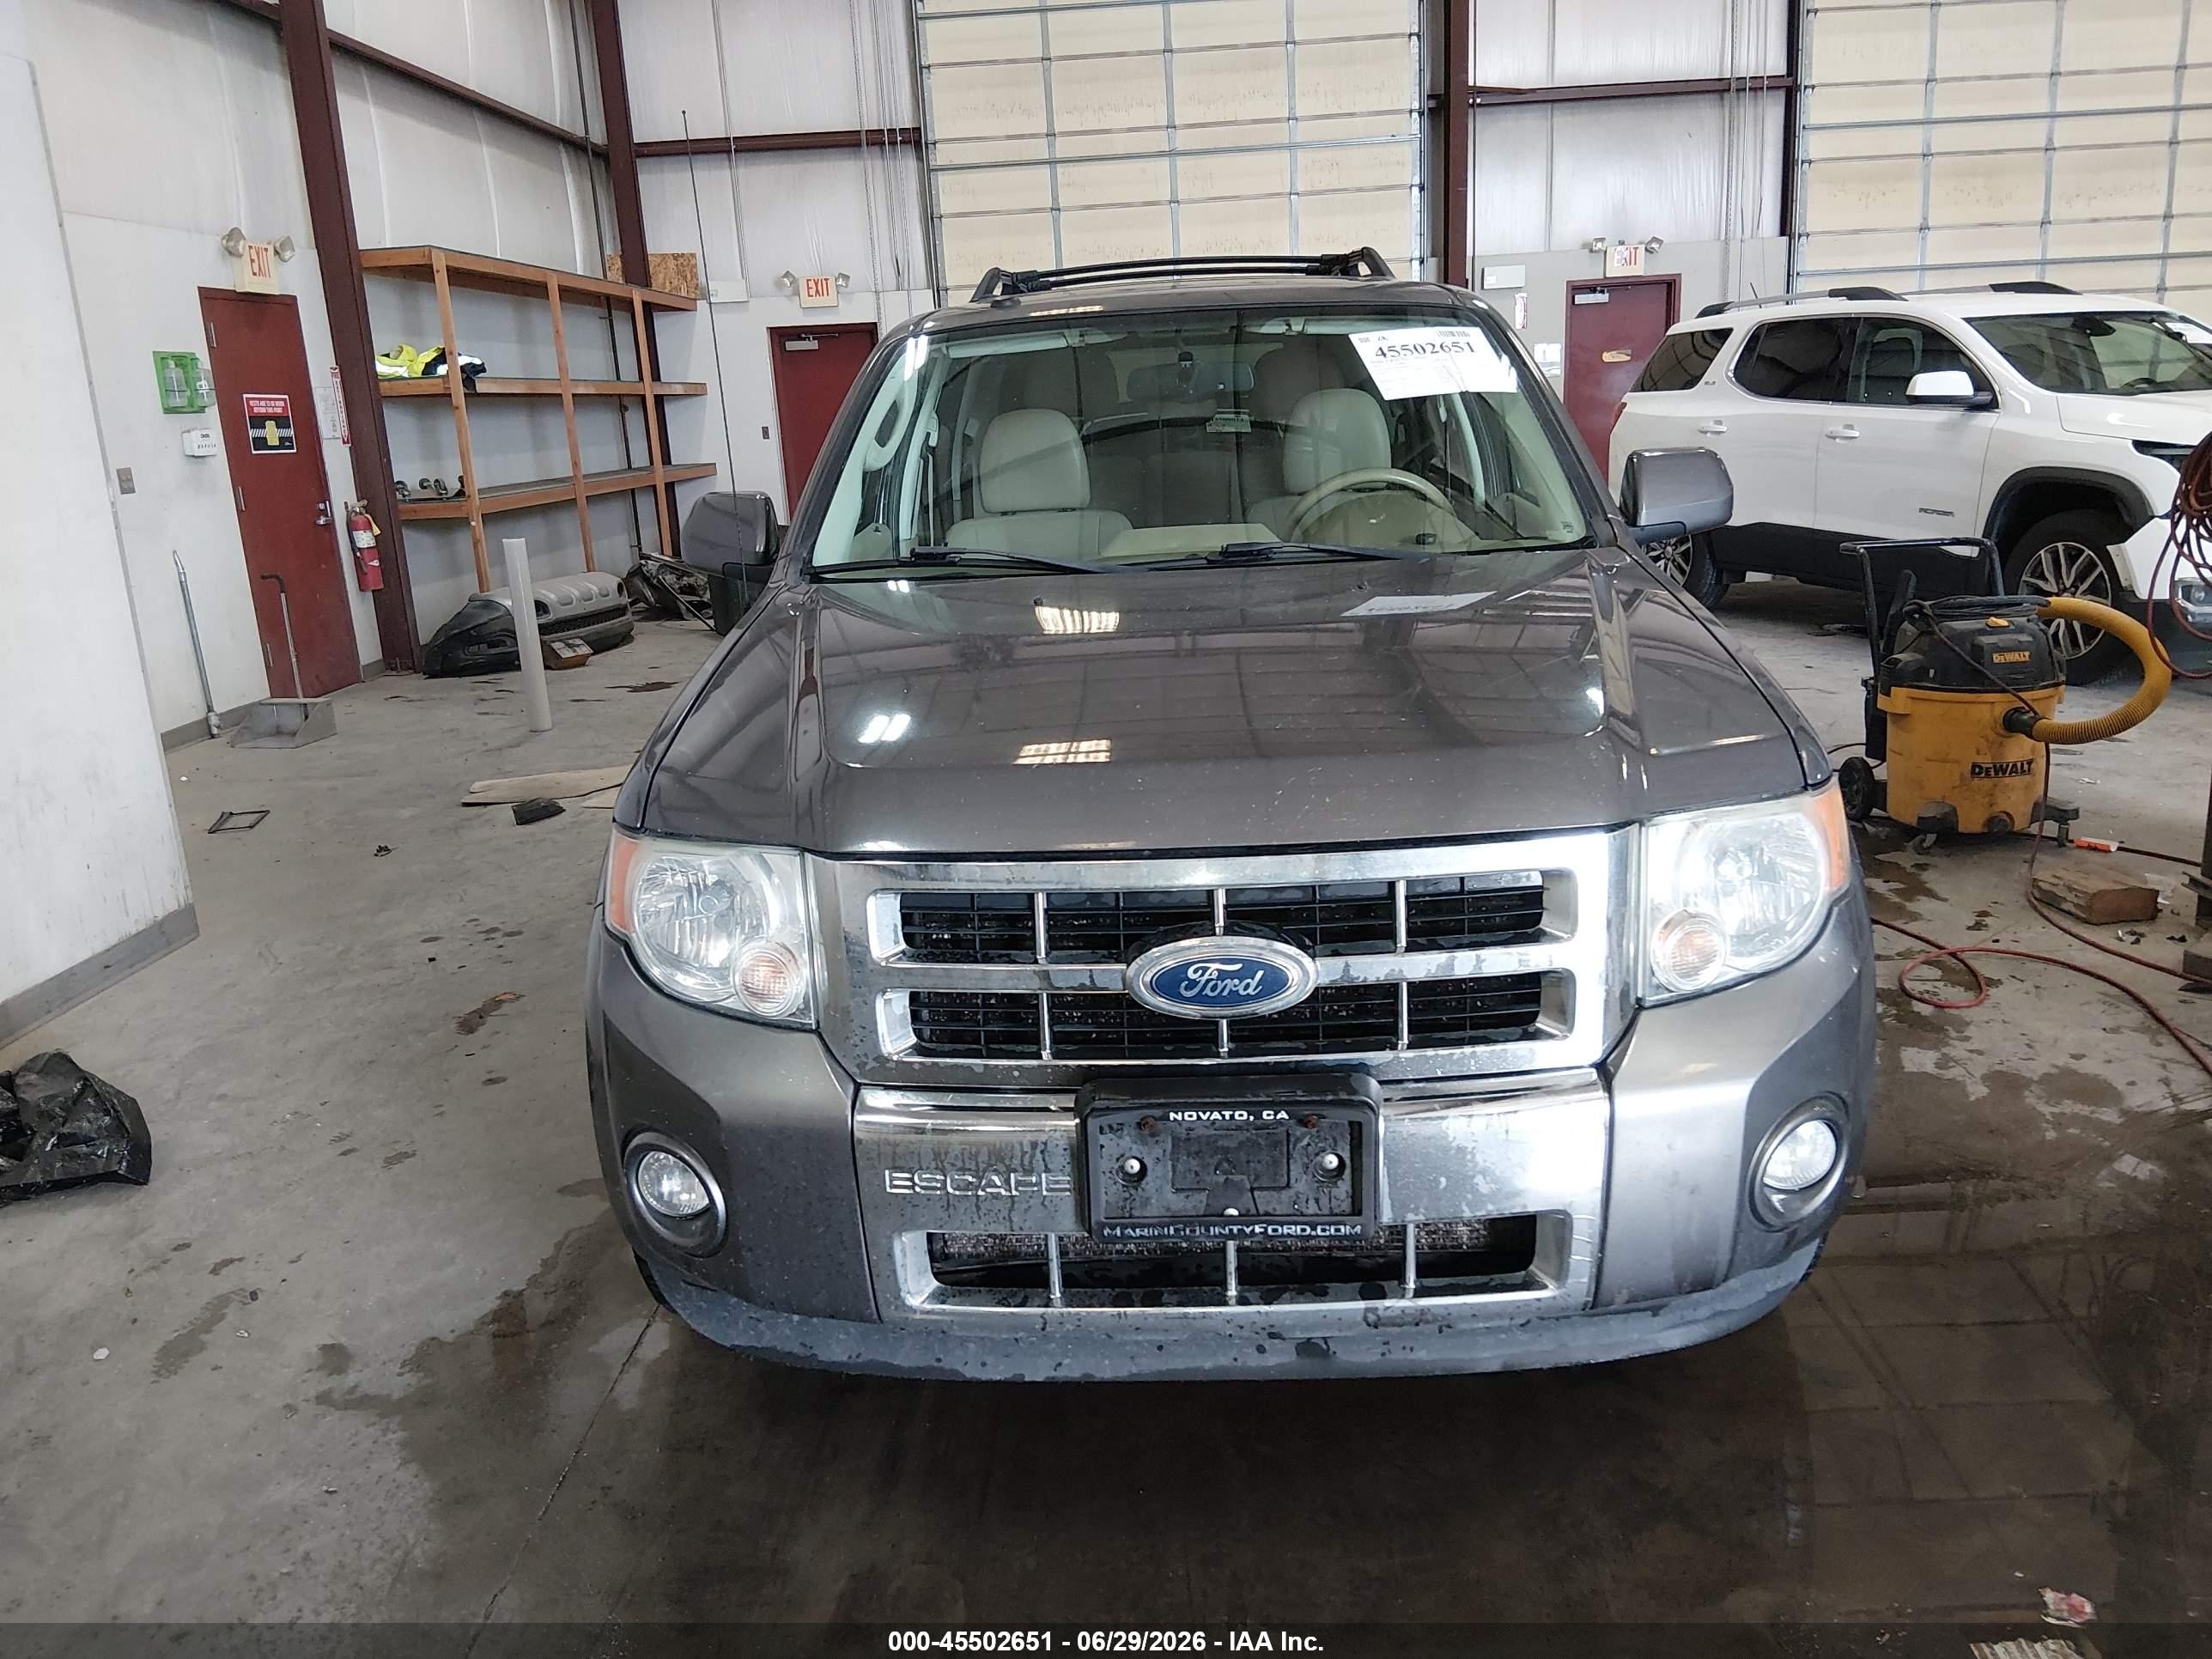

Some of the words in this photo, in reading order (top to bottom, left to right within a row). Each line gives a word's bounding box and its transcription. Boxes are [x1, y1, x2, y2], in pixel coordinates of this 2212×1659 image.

[247, 245, 271, 278] EXIT
[805, 277, 830, 297] EXIT
[1375, 341, 1477, 359] 45502651
[1179, 963, 1265, 998] Ford
[1169, 1110, 1255, 1121] NOVATO,
[1261, 1109, 1290, 1120] CA
[884, 1166, 1072, 1196] ESCAPE
